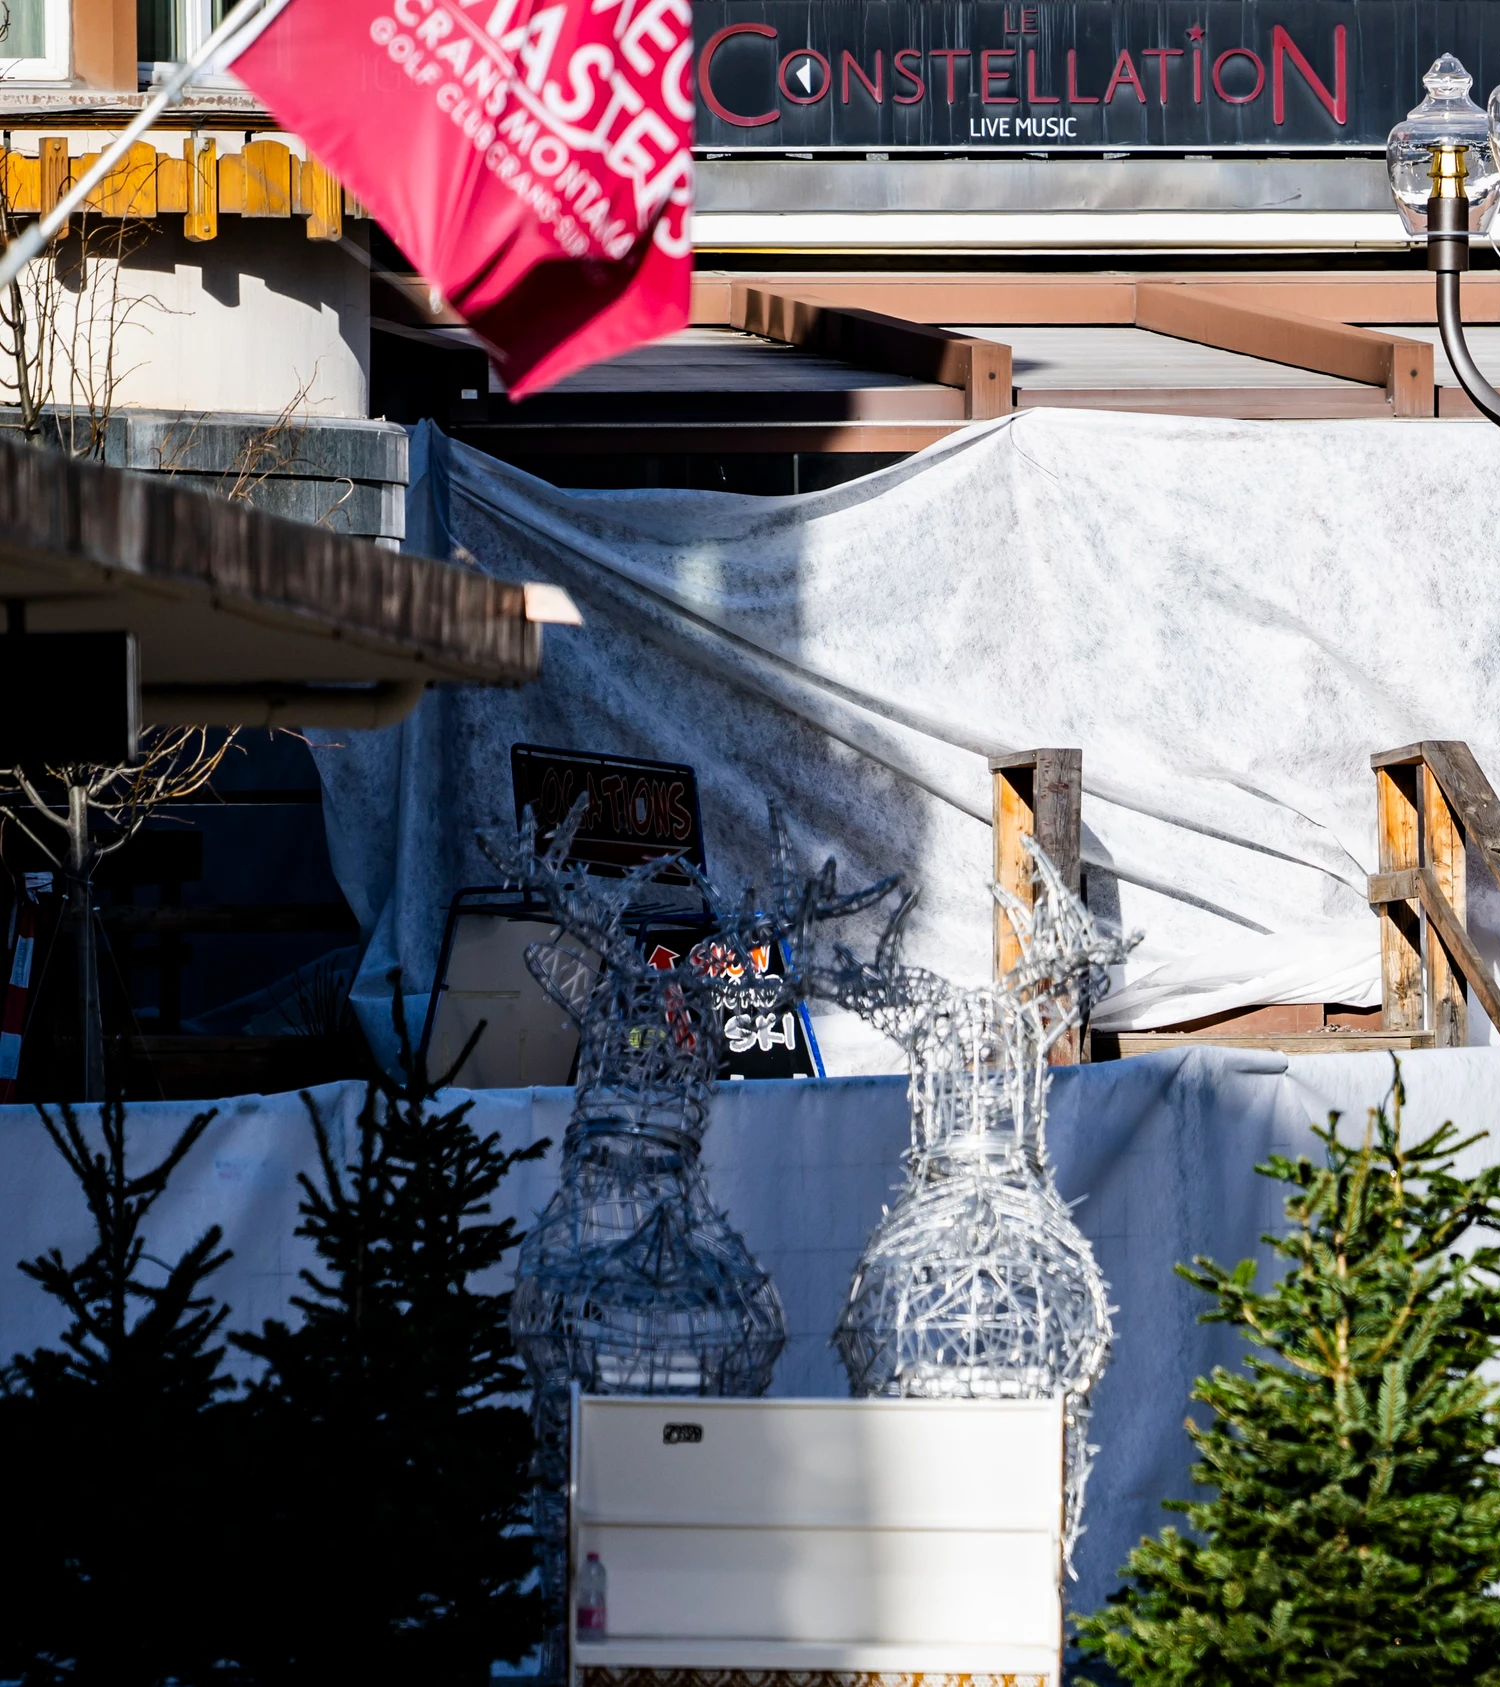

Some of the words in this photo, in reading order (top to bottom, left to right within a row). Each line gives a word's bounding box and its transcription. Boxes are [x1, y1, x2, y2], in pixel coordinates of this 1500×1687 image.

[1004, 9, 1038, 33] LE
[370, 16, 443, 86] GOLF
[436, 82, 497, 152] CLUB
[698, 22, 1347, 126] CONSTELLATION
[970, 118, 1010, 137] LIVE
[1015, 117, 1077, 137] MUSIC
[724, 1012, 796, 1053] SKI
